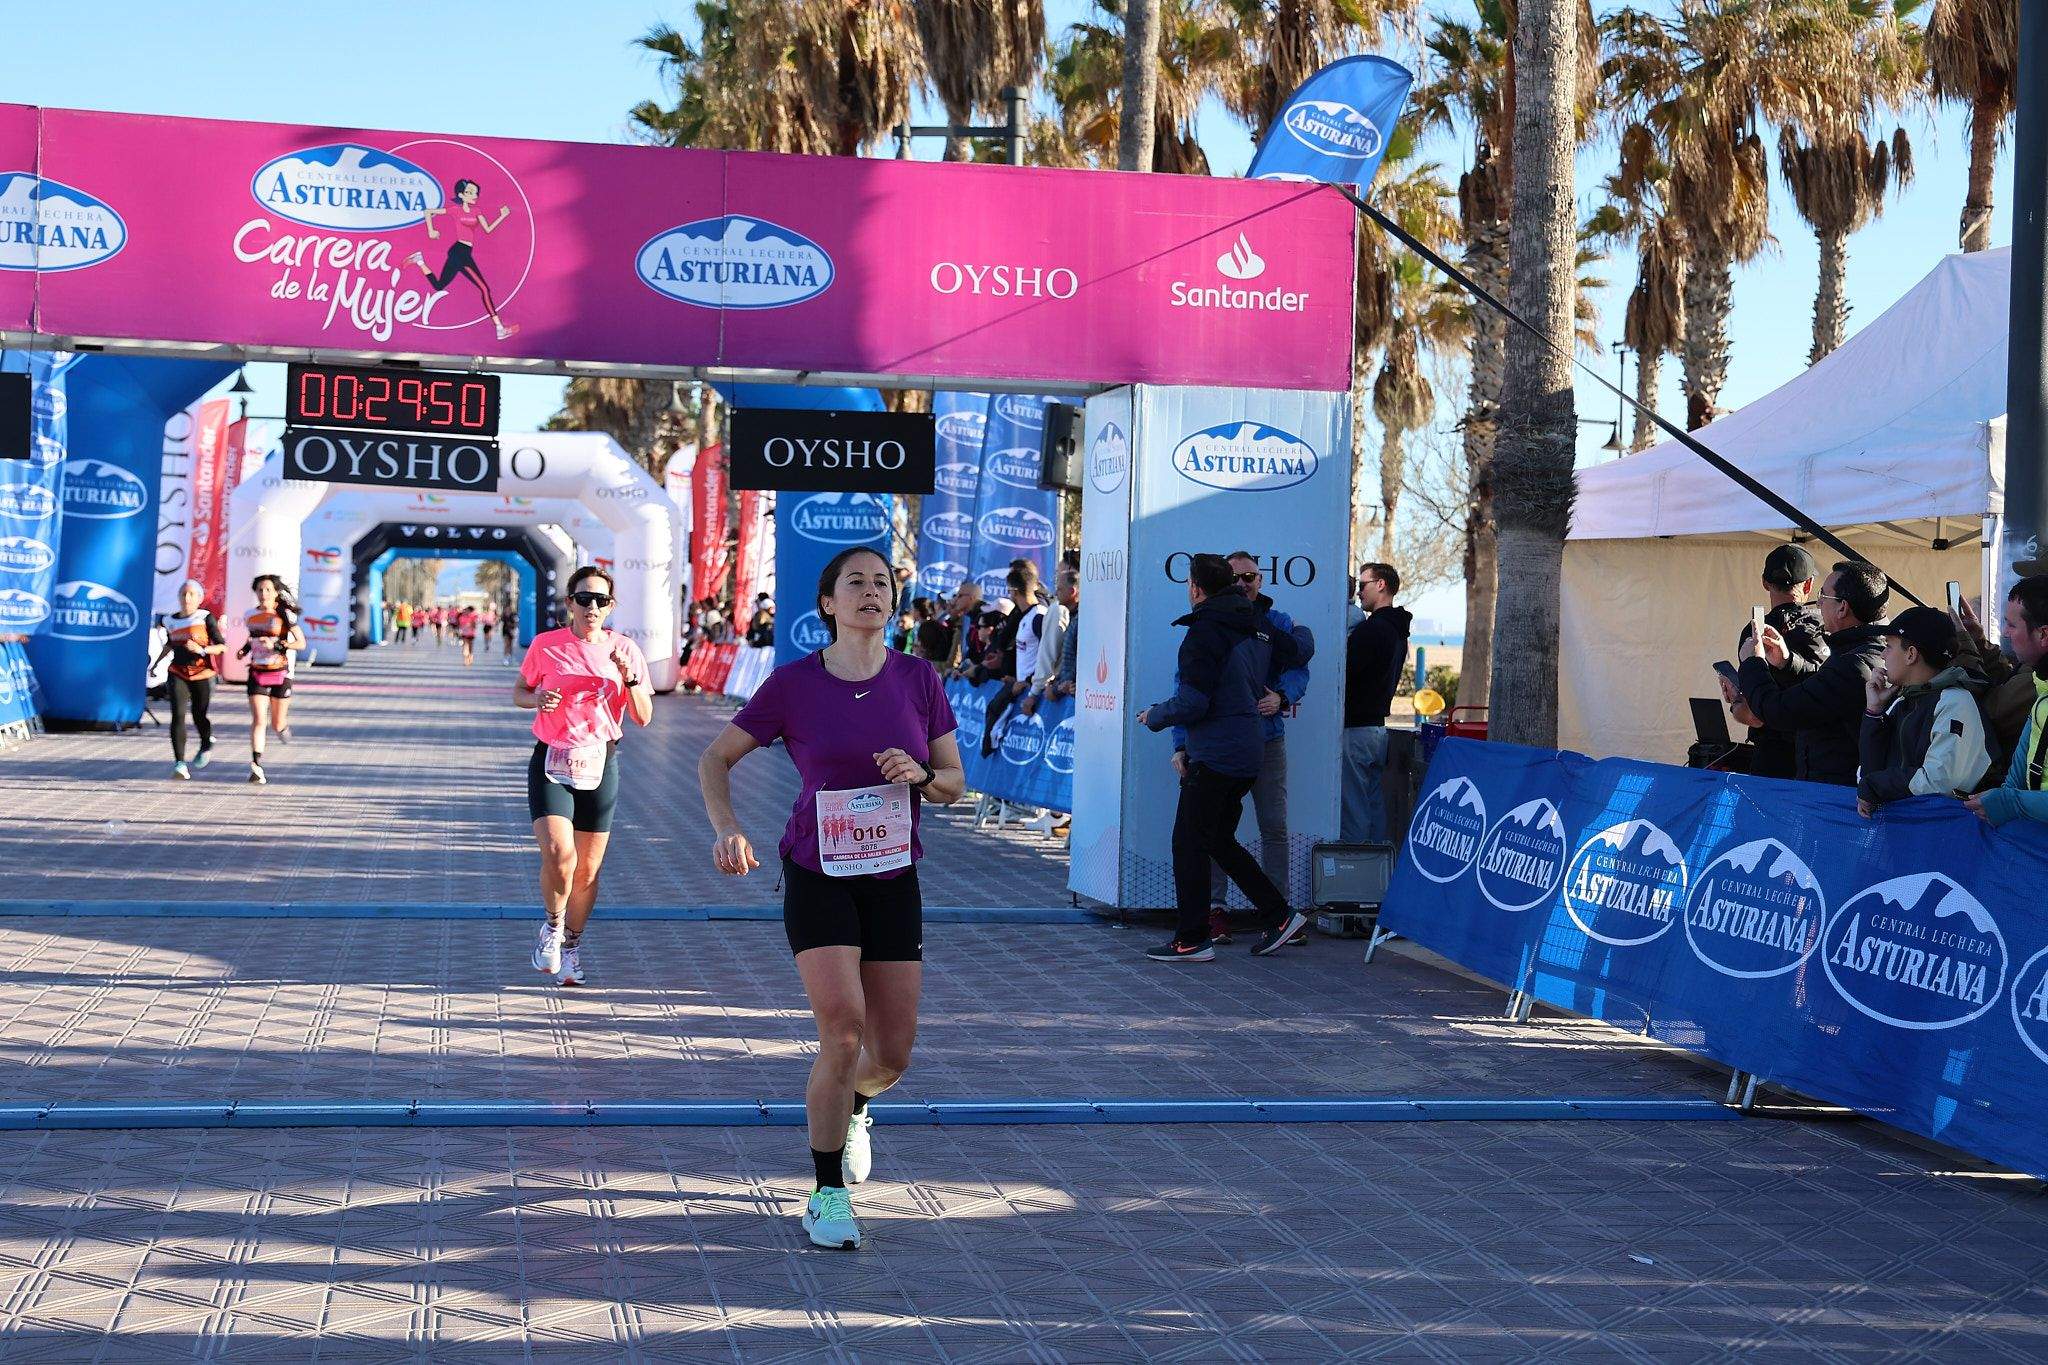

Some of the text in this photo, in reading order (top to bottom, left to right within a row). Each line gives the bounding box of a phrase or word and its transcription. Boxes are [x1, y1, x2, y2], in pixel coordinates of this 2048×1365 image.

[268, 171, 428, 211] ASTURIANA
[297, 170, 426, 187] CENTRAL LECHERA
[233, 218, 393, 271] Carrera
[683, 246, 813, 260] CENTRAL LECHERA
[652, 247, 819, 286] ASTURIANA
[929, 262, 1079, 300] OYSHO
[270, 267, 450, 342] de la Mujer
[1170, 281, 1310, 312] Santander
[300, 372, 486, 428] 00:29:50
[294, 436, 490, 485] OYSHO
[763, 437, 906, 470] OYSHO
[1182, 445, 1307, 476] ASTURIANA
[1205, 444, 1303, 455] CENTRAL LECHERA
[400, 525, 507, 540] VOLVO
[1086, 549, 1124, 583] OYSHO
[1164, 551, 1316, 587] OHO
[853, 824, 887, 842] 016
[1413, 805, 1475, 863] ASTURIANA
[1531, 836, 1560, 855] LECHERA
[832, 863, 863, 872] OYSHO
[1480, 830, 1555, 890] ASTURIANA
[1596, 855, 1679, 884] CENTRAL LECHERA
[1569, 854, 1675, 923] ASTURIANA
[1721, 879, 1813, 911] CENTRAL LECHERA
[1690, 878, 1809, 953] ASTURIANA
[1871, 914, 1993, 957] CENTRAL LECHERA
[1829, 912, 1987, 1005] ASTURIANA
